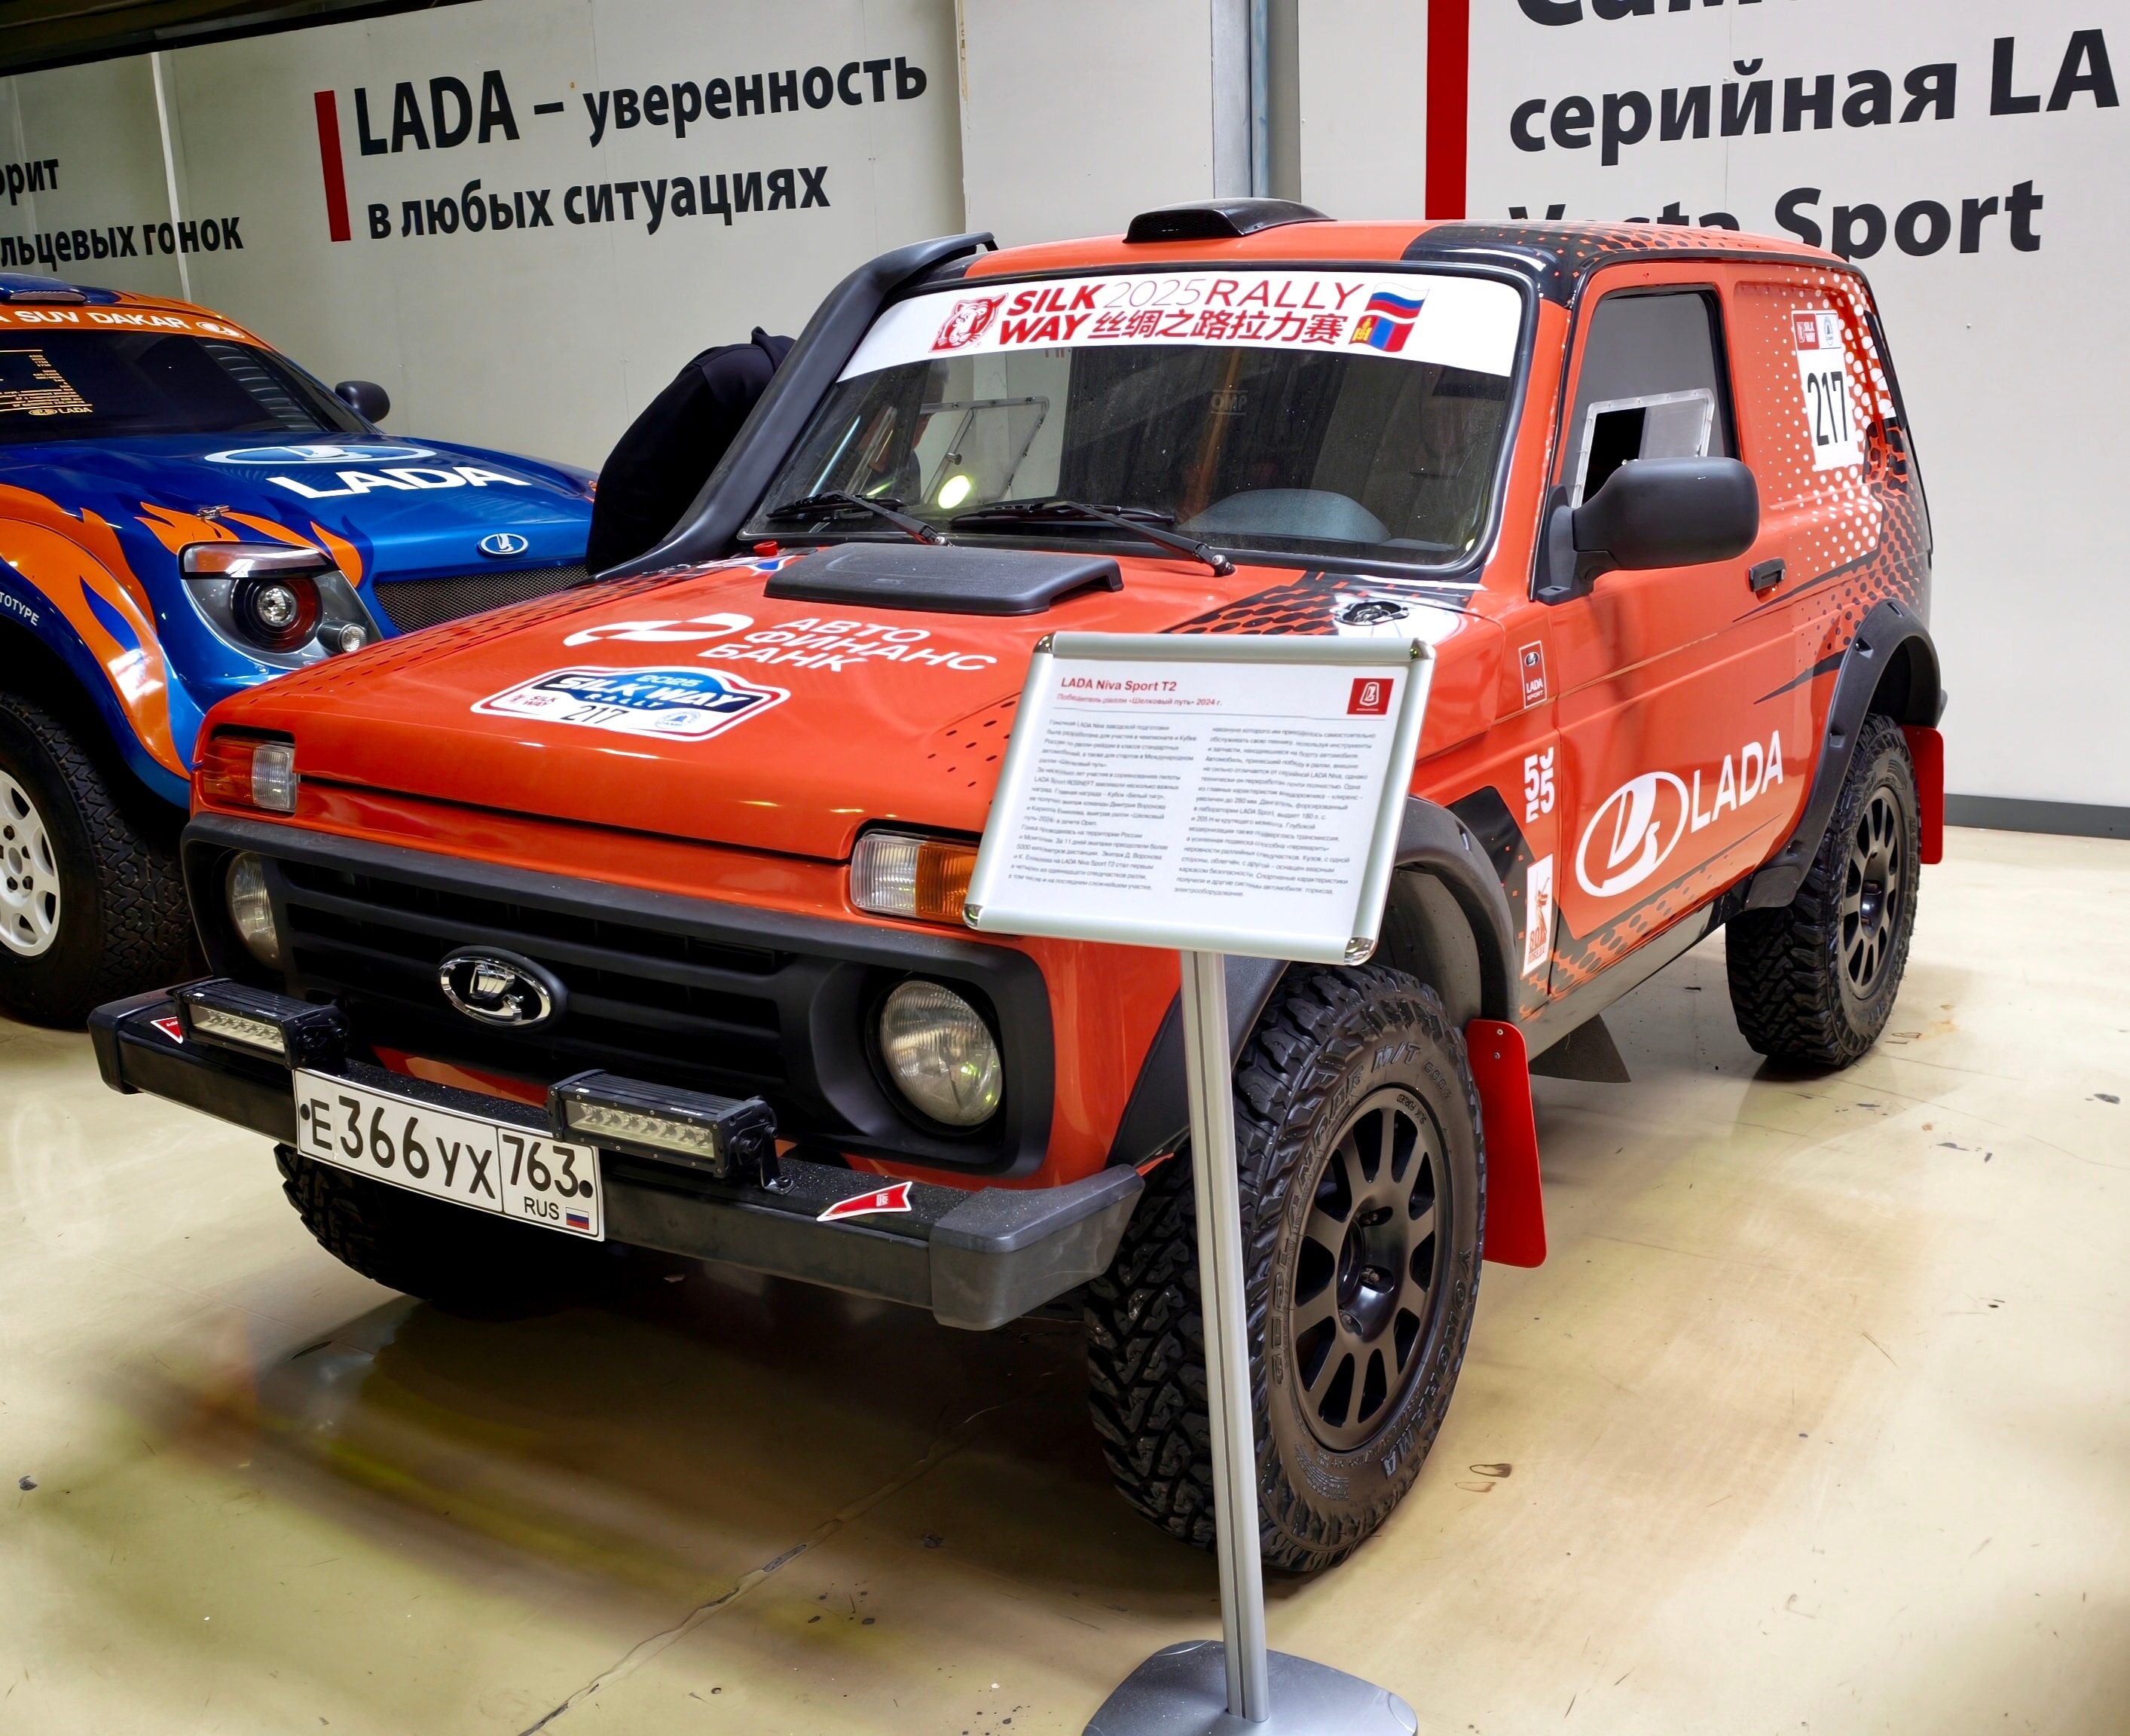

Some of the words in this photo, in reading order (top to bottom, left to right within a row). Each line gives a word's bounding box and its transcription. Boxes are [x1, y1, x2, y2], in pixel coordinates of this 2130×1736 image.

[354, 69, 520, 156] LADA
[583, 57, 927, 148] уверенность
[1509, 58, 1957, 167] серийная
[369, 202, 392, 240] в
[402, 179, 555, 238] любых
[564, 166, 830, 235] ситуациях
[143, 216, 243, 255] гонок
[1774, 179, 2043, 263] Sport
[1007, 283, 1107, 316] SILK
[1103, 279, 1206, 308] 2025
[1204, 280, 1364, 310] RALLY
[14, 310, 80, 323] SUV
[85, 312, 191, 329] DAKAR
[998, 313, 1093, 345] WAY
[1087, 309, 1347, 345] 丝绸之路拉力赛
[1808, 371, 1848, 447] 217
[265, 466, 532, 499] LADA
[770, 618, 931, 643] АВТО
[697, 643, 868, 672] БАНК
[744, 631, 997, 670] ФИНАНС
[544, 676, 659, 697] SILK
[645, 686, 750, 708] WAY
[636, 674, 702, 687] 2025
[1060, 677, 1093, 689] LADA
[1096, 680, 1122, 690] Niva
[1124, 680, 1159, 692] Sport
[1161, 680, 1177, 692] T2
[1526, 677, 1543, 693] LADA
[560, 705, 630, 724] 217
[584, 693, 665, 708] RALLY
[1691, 729, 1783, 833] LADA
[1371, 1043, 1421, 1073] M/T
[502, 1134, 579, 1198] 763
[524, 1196, 560, 1221] RUS
[1380, 1249, 1472, 1481] YOKOHAMA
